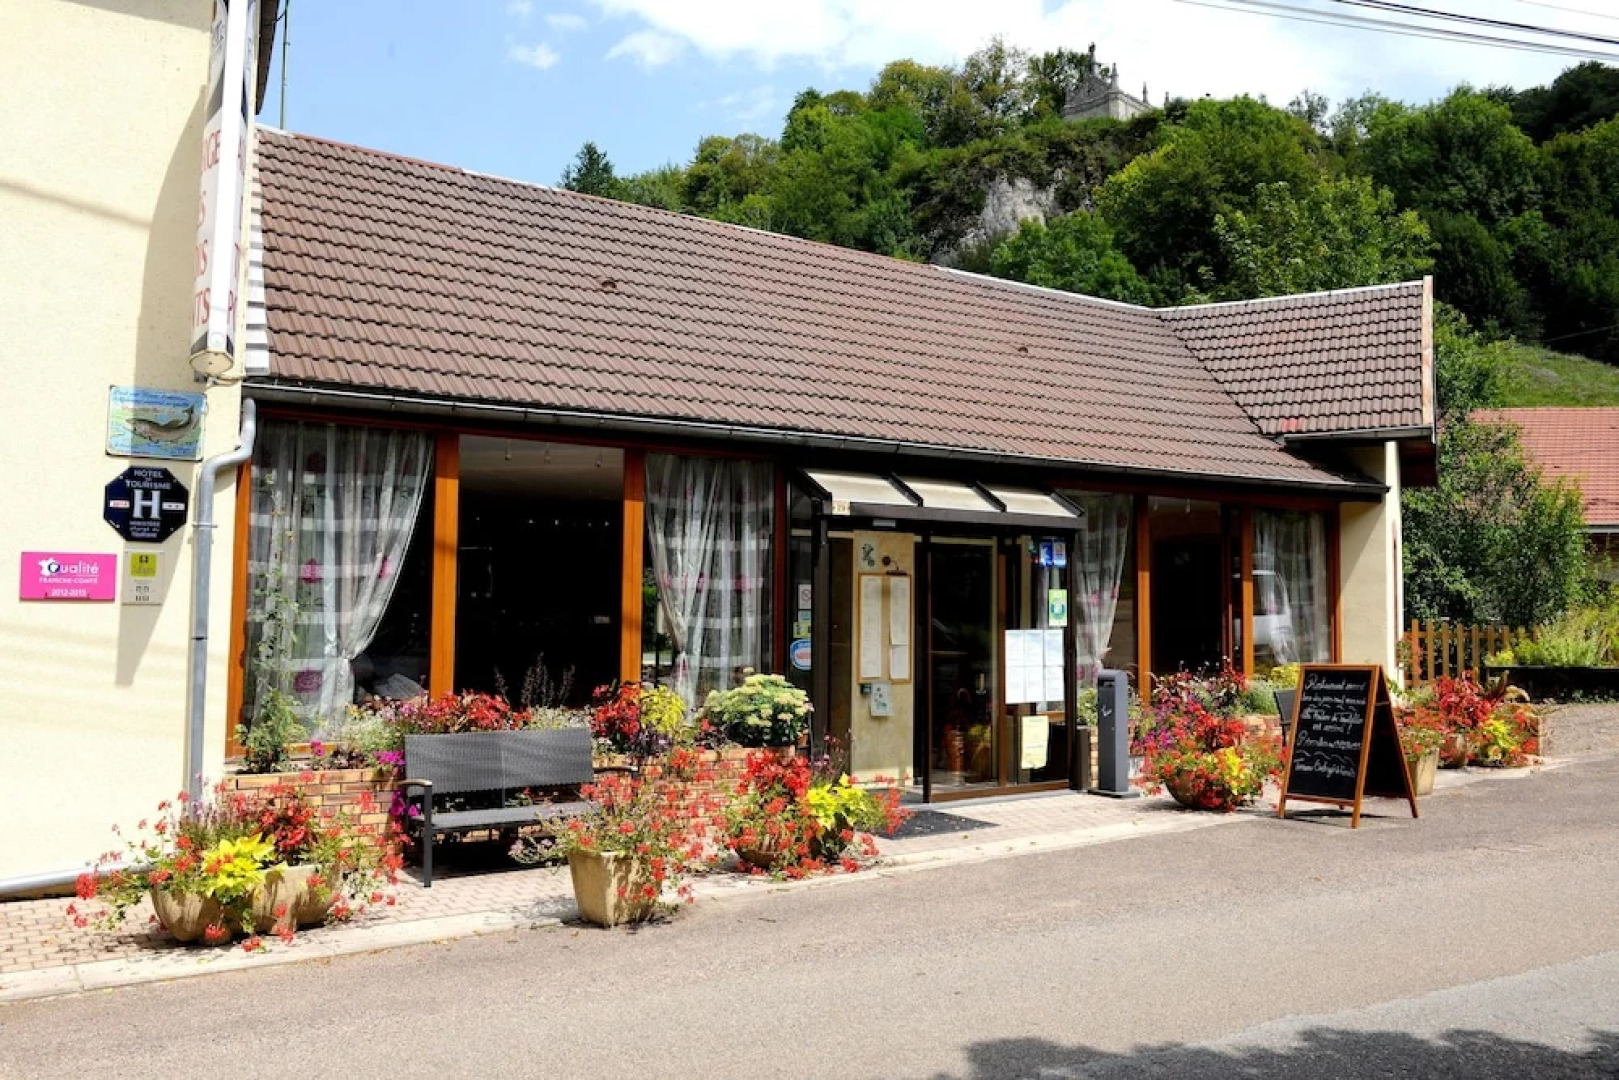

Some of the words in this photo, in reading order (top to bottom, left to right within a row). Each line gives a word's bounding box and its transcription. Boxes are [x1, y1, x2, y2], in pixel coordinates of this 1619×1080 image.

[134, 469, 164, 479] HÔTEL
[125, 479, 171, 490] TOURISME
[133, 489, 162, 520] H
[48, 560, 100, 575] Qualité
